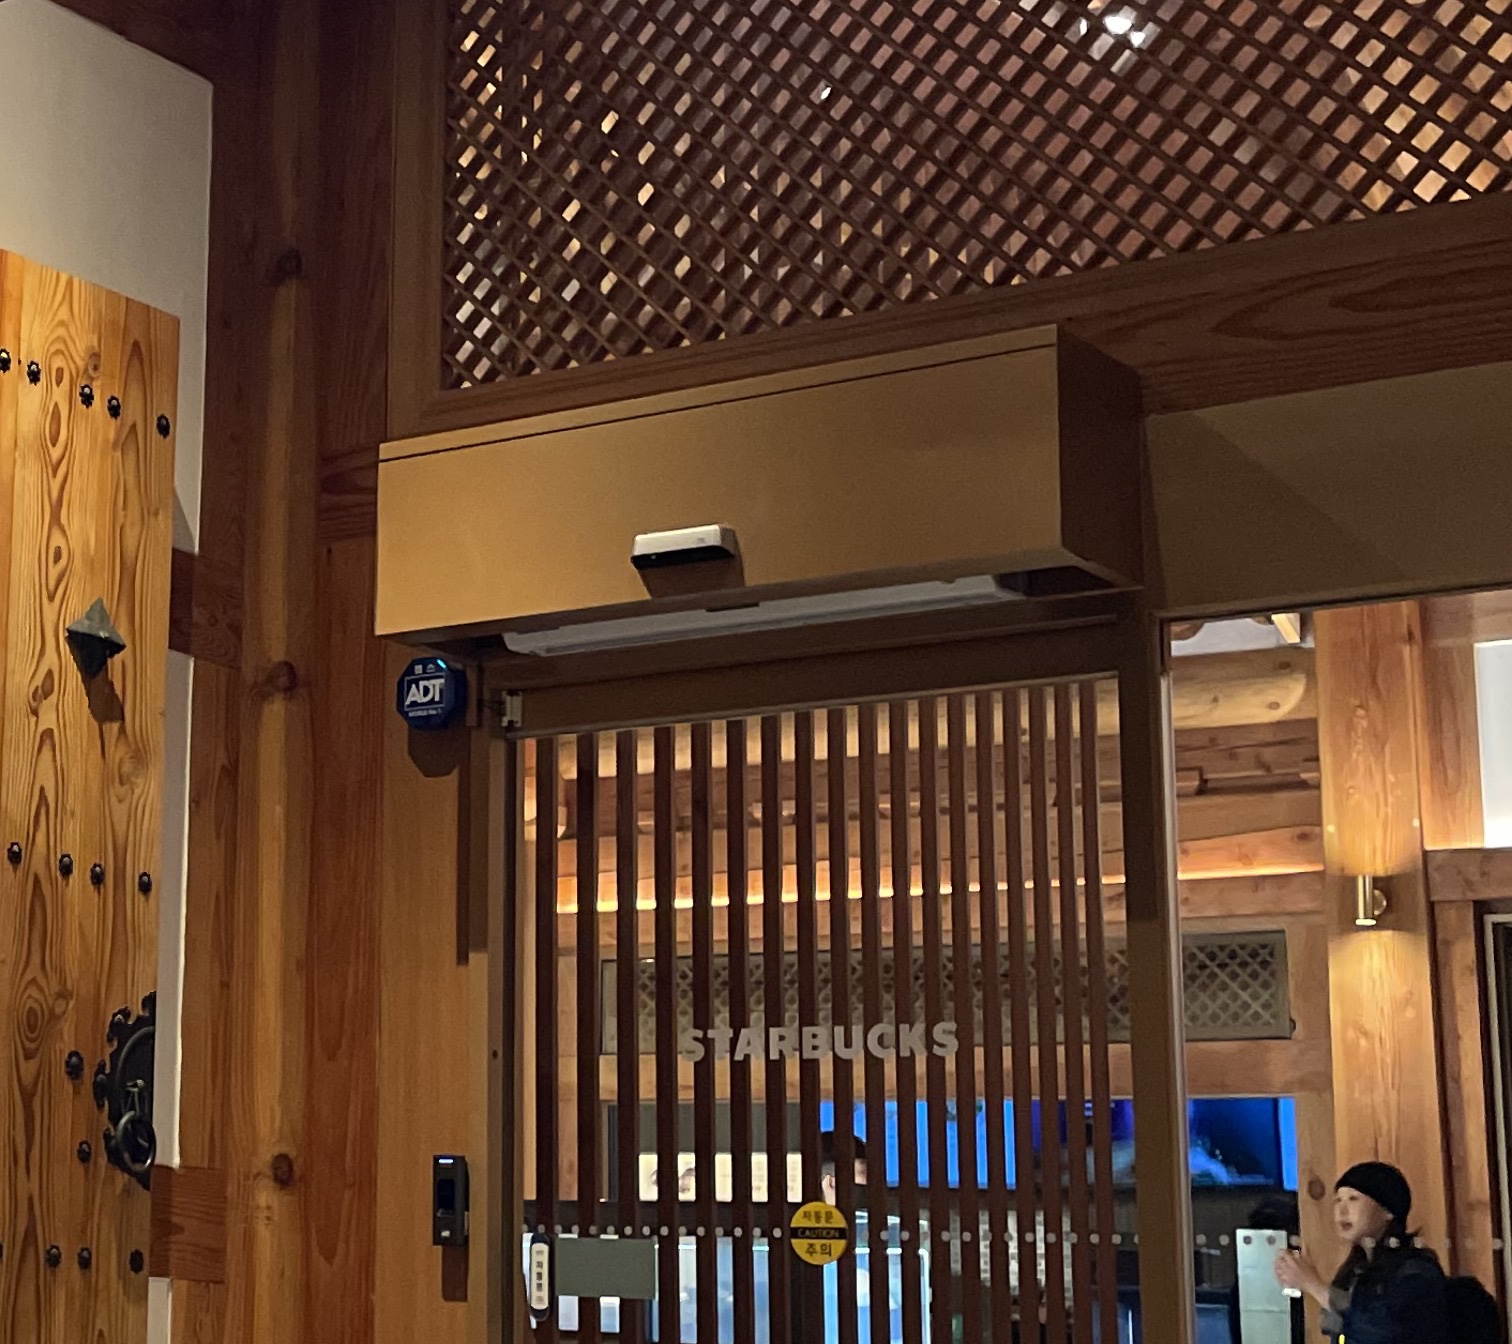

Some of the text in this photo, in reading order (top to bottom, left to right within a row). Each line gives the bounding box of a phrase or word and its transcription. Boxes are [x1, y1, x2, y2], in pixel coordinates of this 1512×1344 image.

[405, 678, 445, 705] ADT
[683, 1022, 959, 1062] STARBUCKS
[797, 1228, 839, 1238] CAUTION
[805, 1242, 832, 1257] 주의
